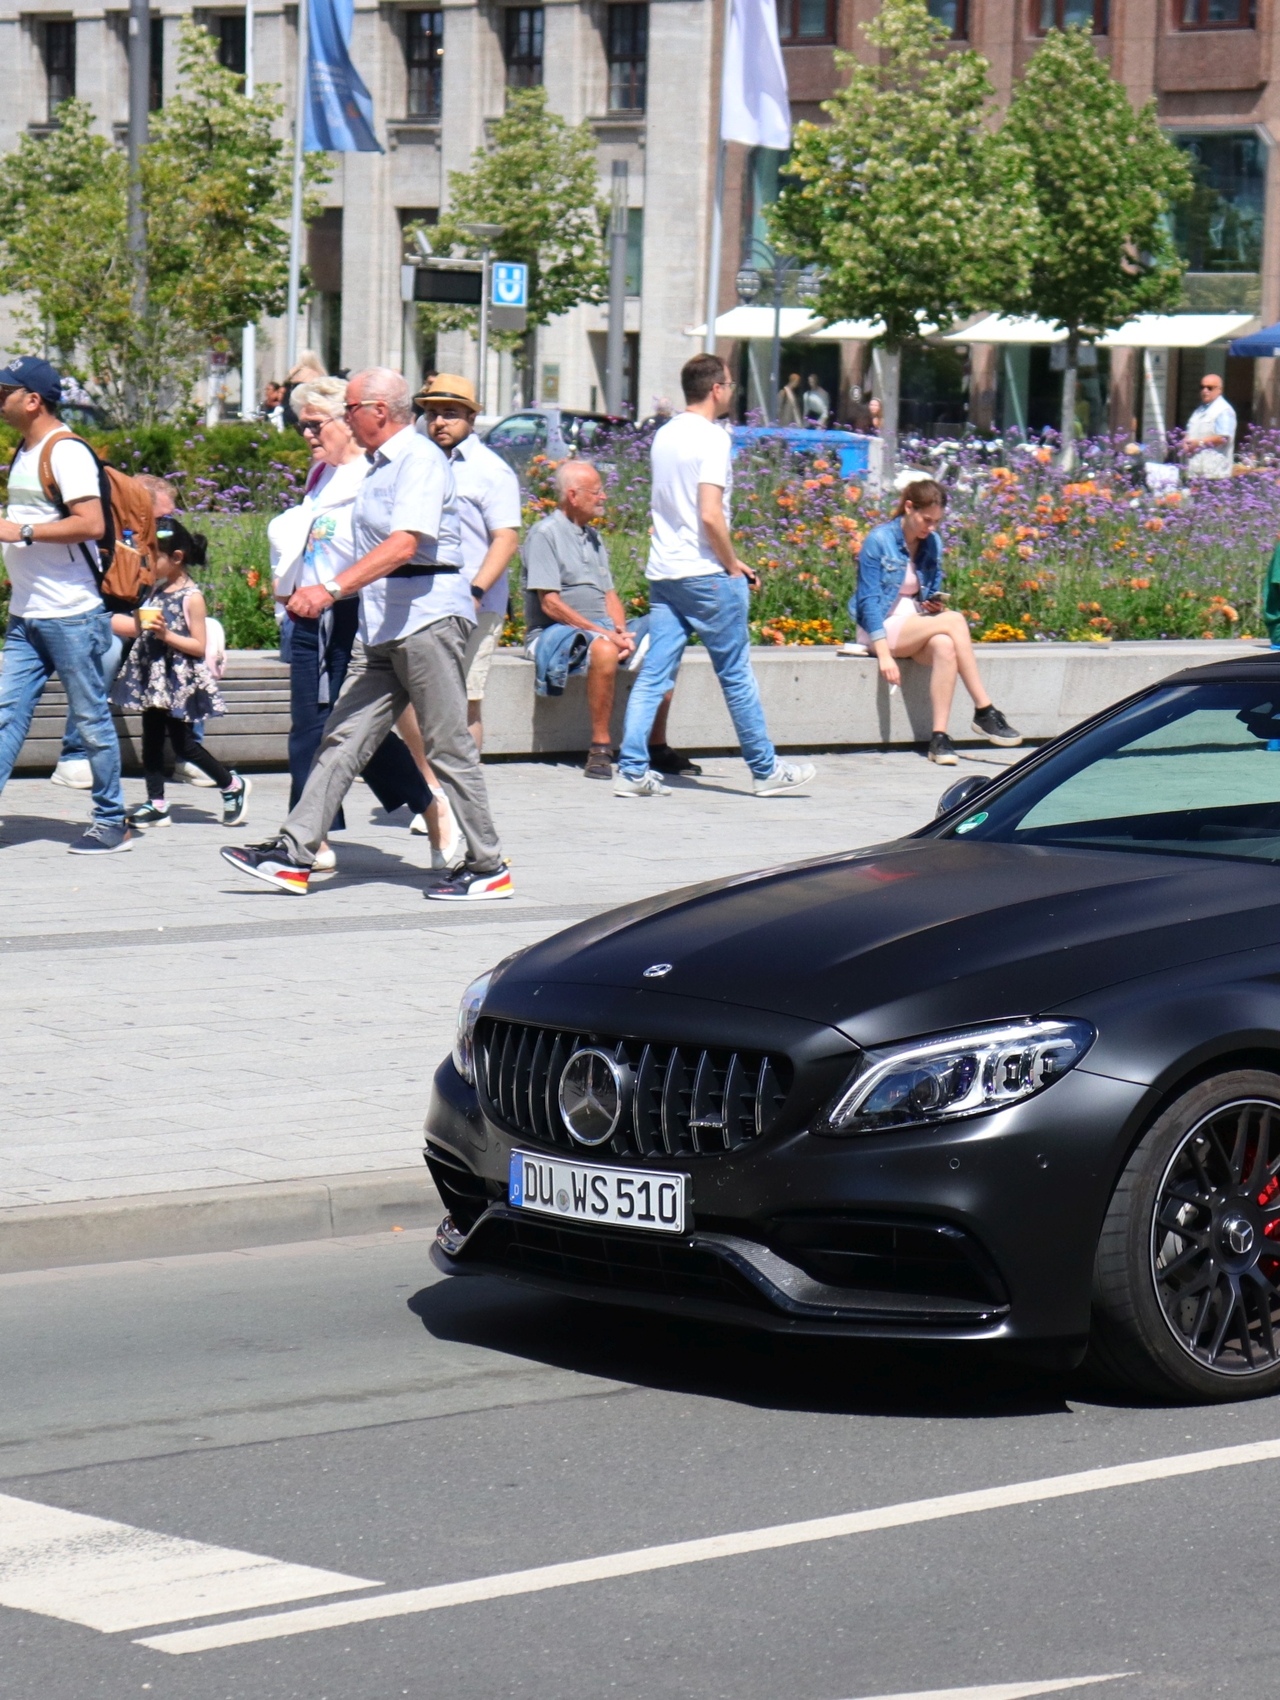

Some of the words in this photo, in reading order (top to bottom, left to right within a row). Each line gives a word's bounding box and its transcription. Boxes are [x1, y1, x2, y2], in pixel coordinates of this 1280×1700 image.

[498, 267, 521, 301] U
[513, 1183, 520, 1196] D
[524, 1161, 554, 1206] DU
[571, 1170, 609, 1215] WS
[616, 1177, 677, 1223] 510
